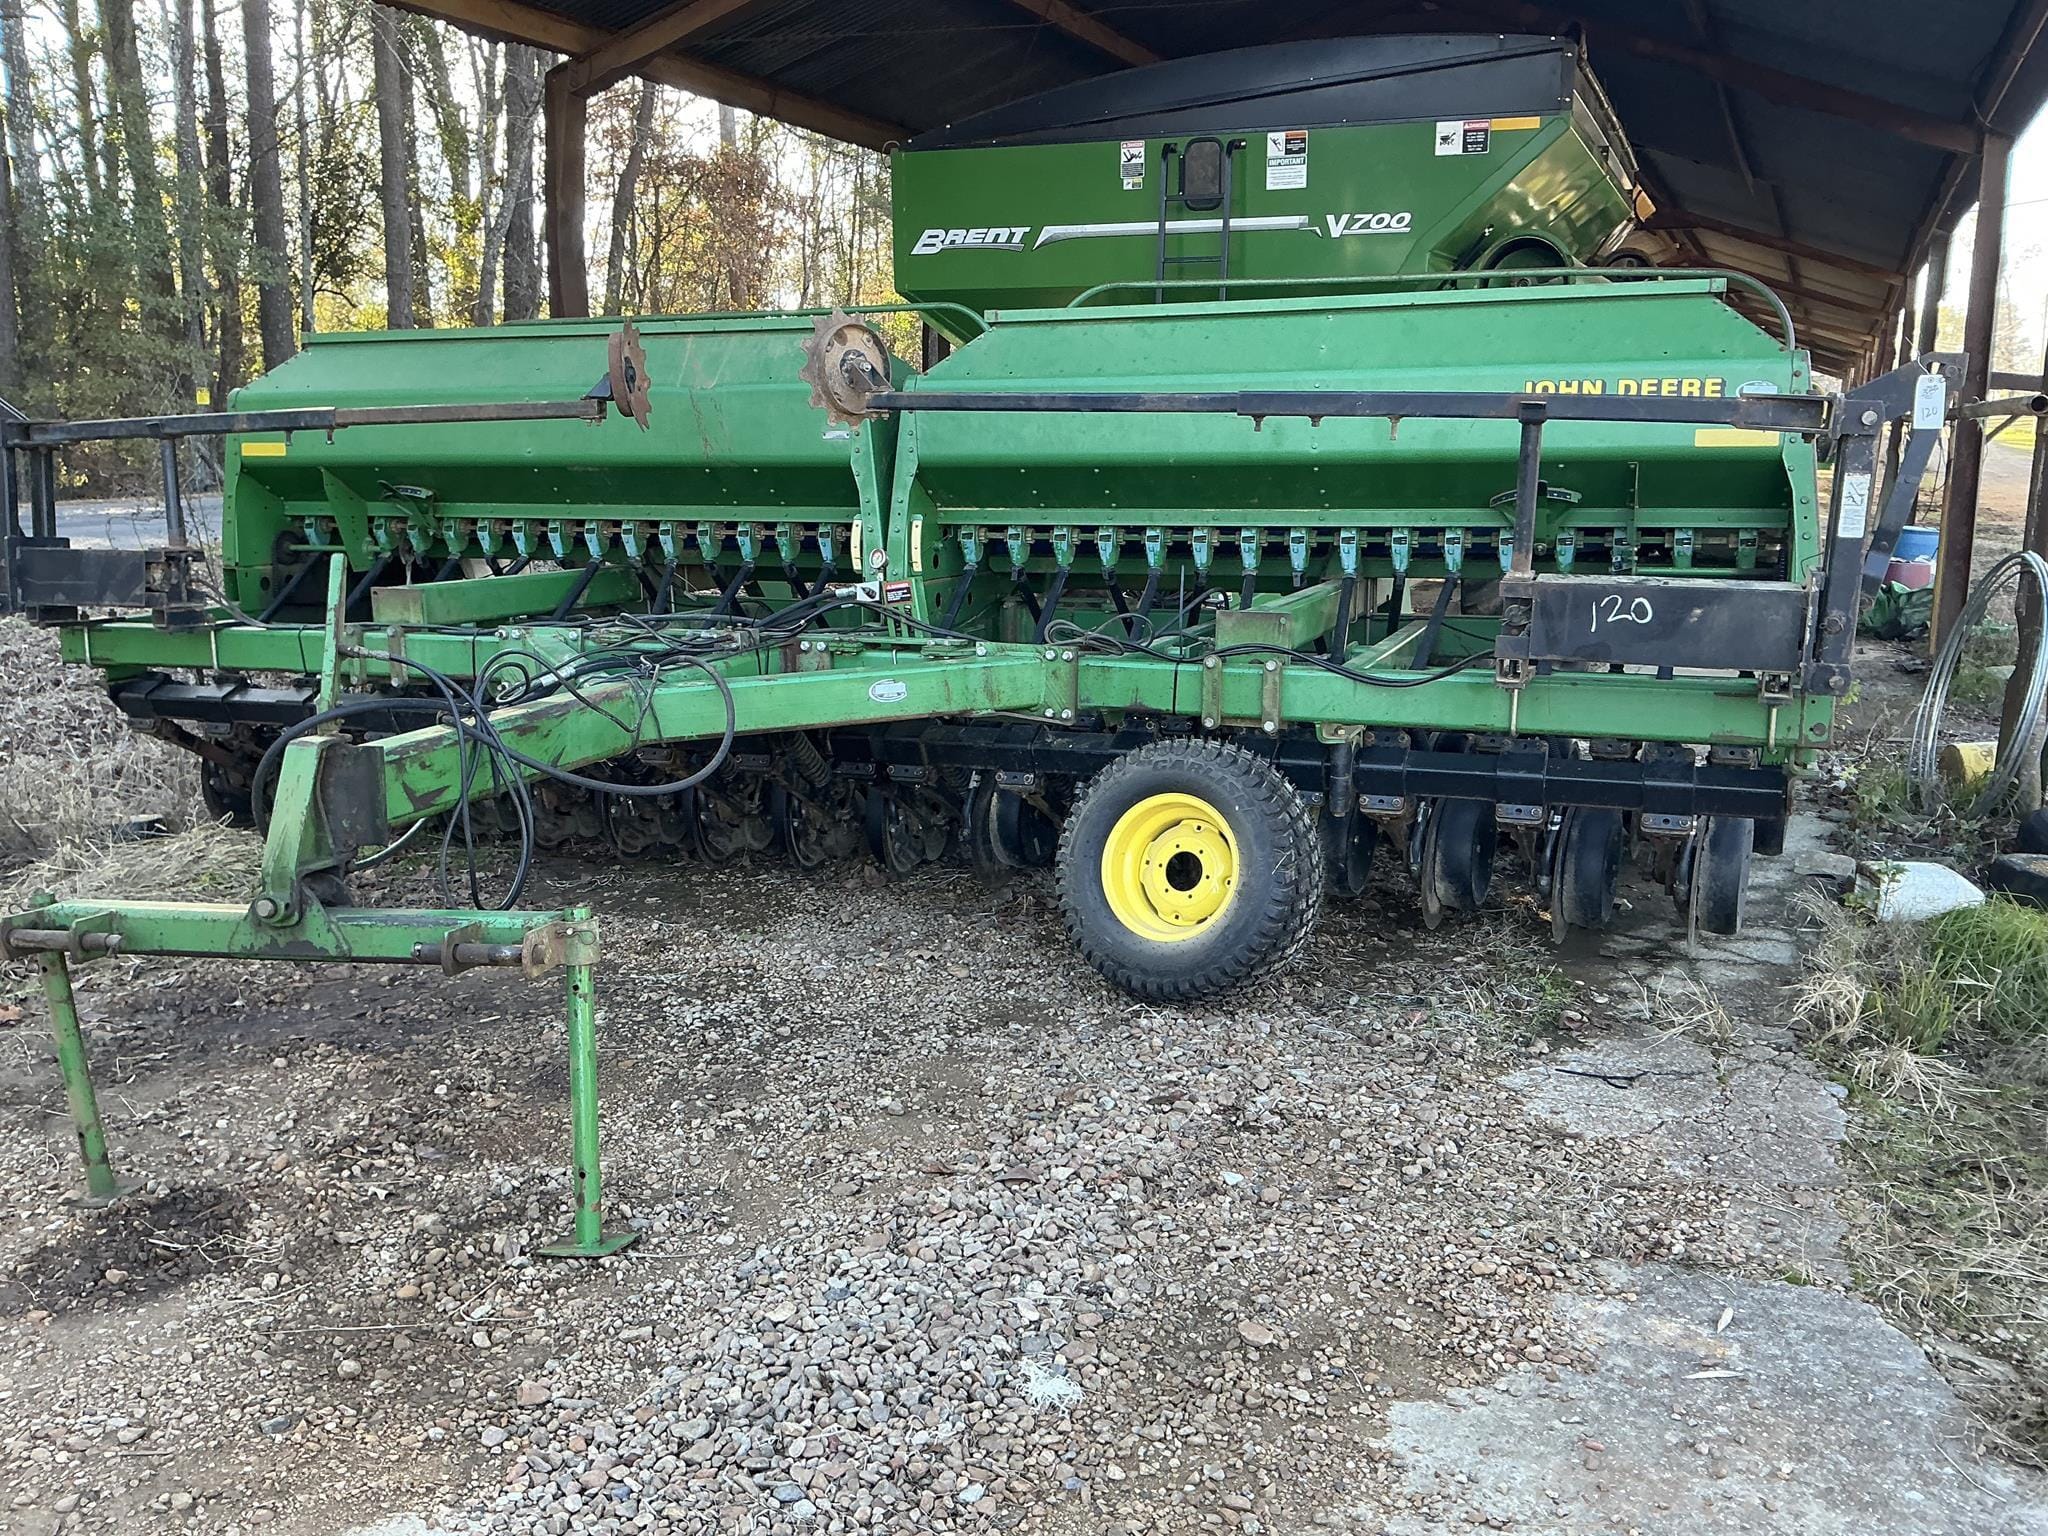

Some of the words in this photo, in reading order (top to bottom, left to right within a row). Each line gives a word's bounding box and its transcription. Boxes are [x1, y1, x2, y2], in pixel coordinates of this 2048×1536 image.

[1269, 157, 1304, 166] IMPORTANT
[1325, 212, 1412, 238] V700
[910, 226, 1031, 255] BRENT
[1616, 377, 1725, 397] DEERE
[1921, 407, 1938, 421] 120
[1590, 595, 1653, 632] 120
